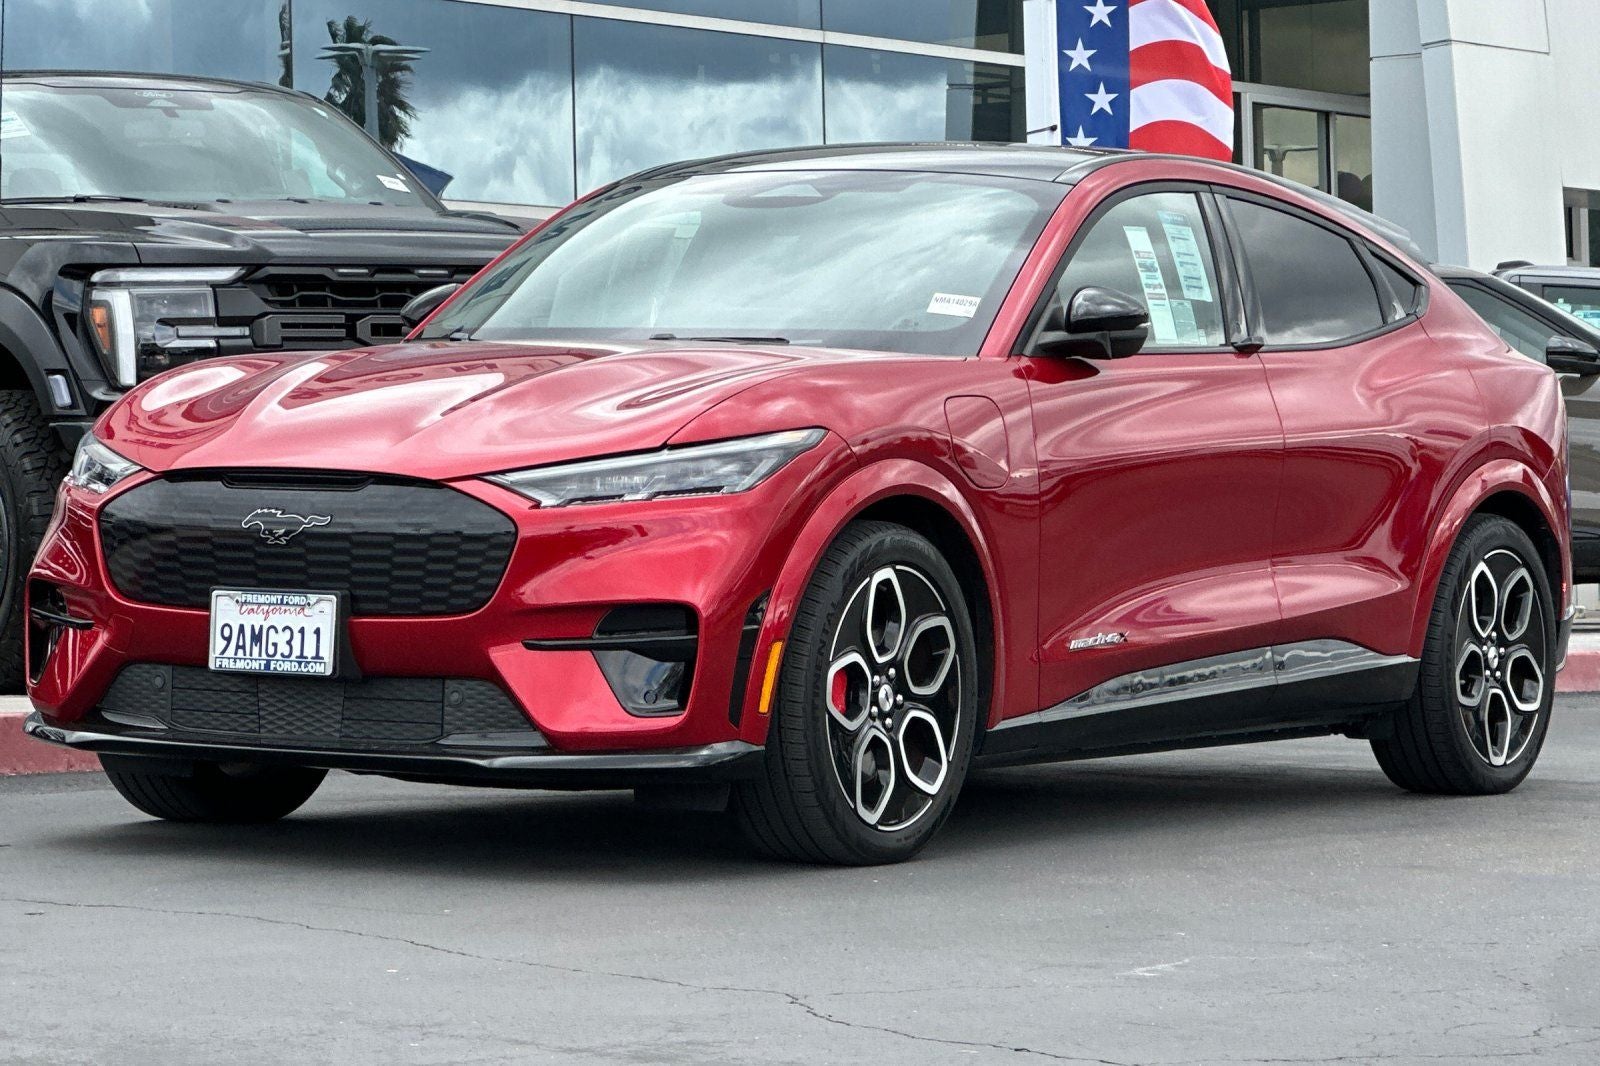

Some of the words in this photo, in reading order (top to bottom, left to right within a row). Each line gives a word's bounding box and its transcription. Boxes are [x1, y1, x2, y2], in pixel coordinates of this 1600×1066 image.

[241, 593, 283, 605] FREMONT
[283, 595, 307, 606] FORD
[238, 603, 313, 621] California
[218, 623, 325, 660] 9AMG311
[215, 659, 267, 671] FREMONT
[270, 660, 325, 674] FORD.COM
